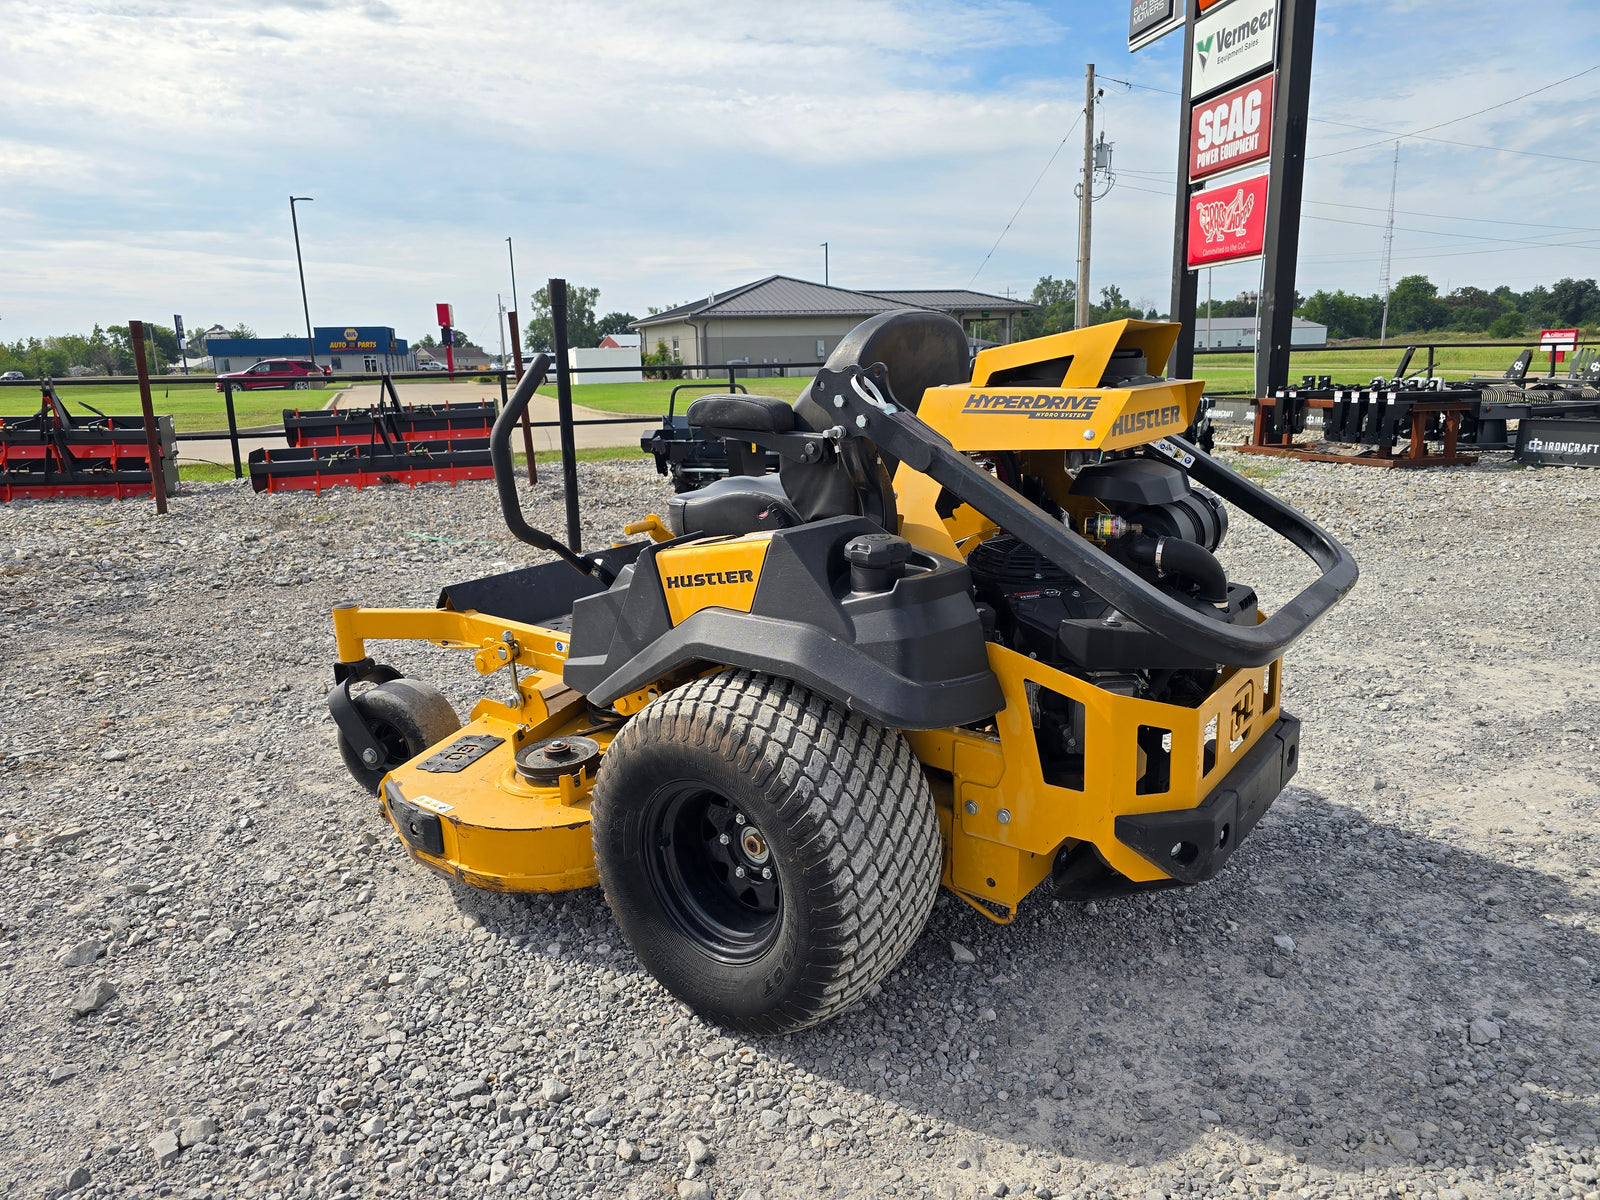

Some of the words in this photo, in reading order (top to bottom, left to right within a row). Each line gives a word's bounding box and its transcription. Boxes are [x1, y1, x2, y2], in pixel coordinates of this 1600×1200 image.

[1133, 2, 1165, 26] MOWERS
[1216, 8, 1274, 53] Vermeer
[1217, 46, 1243, 65] Equipment
[1244, 39, 1259, 51] Sales
[1198, 89, 1262, 151] SCAG
[1197, 147, 1219, 169] POWER
[1220, 133, 1260, 161] EQUIPMENT
[1112, 405, 1180, 437] HUSTLER
[1544, 441, 1600, 454] IRONCRAFT
[666, 569, 754, 590] HUSTLER
